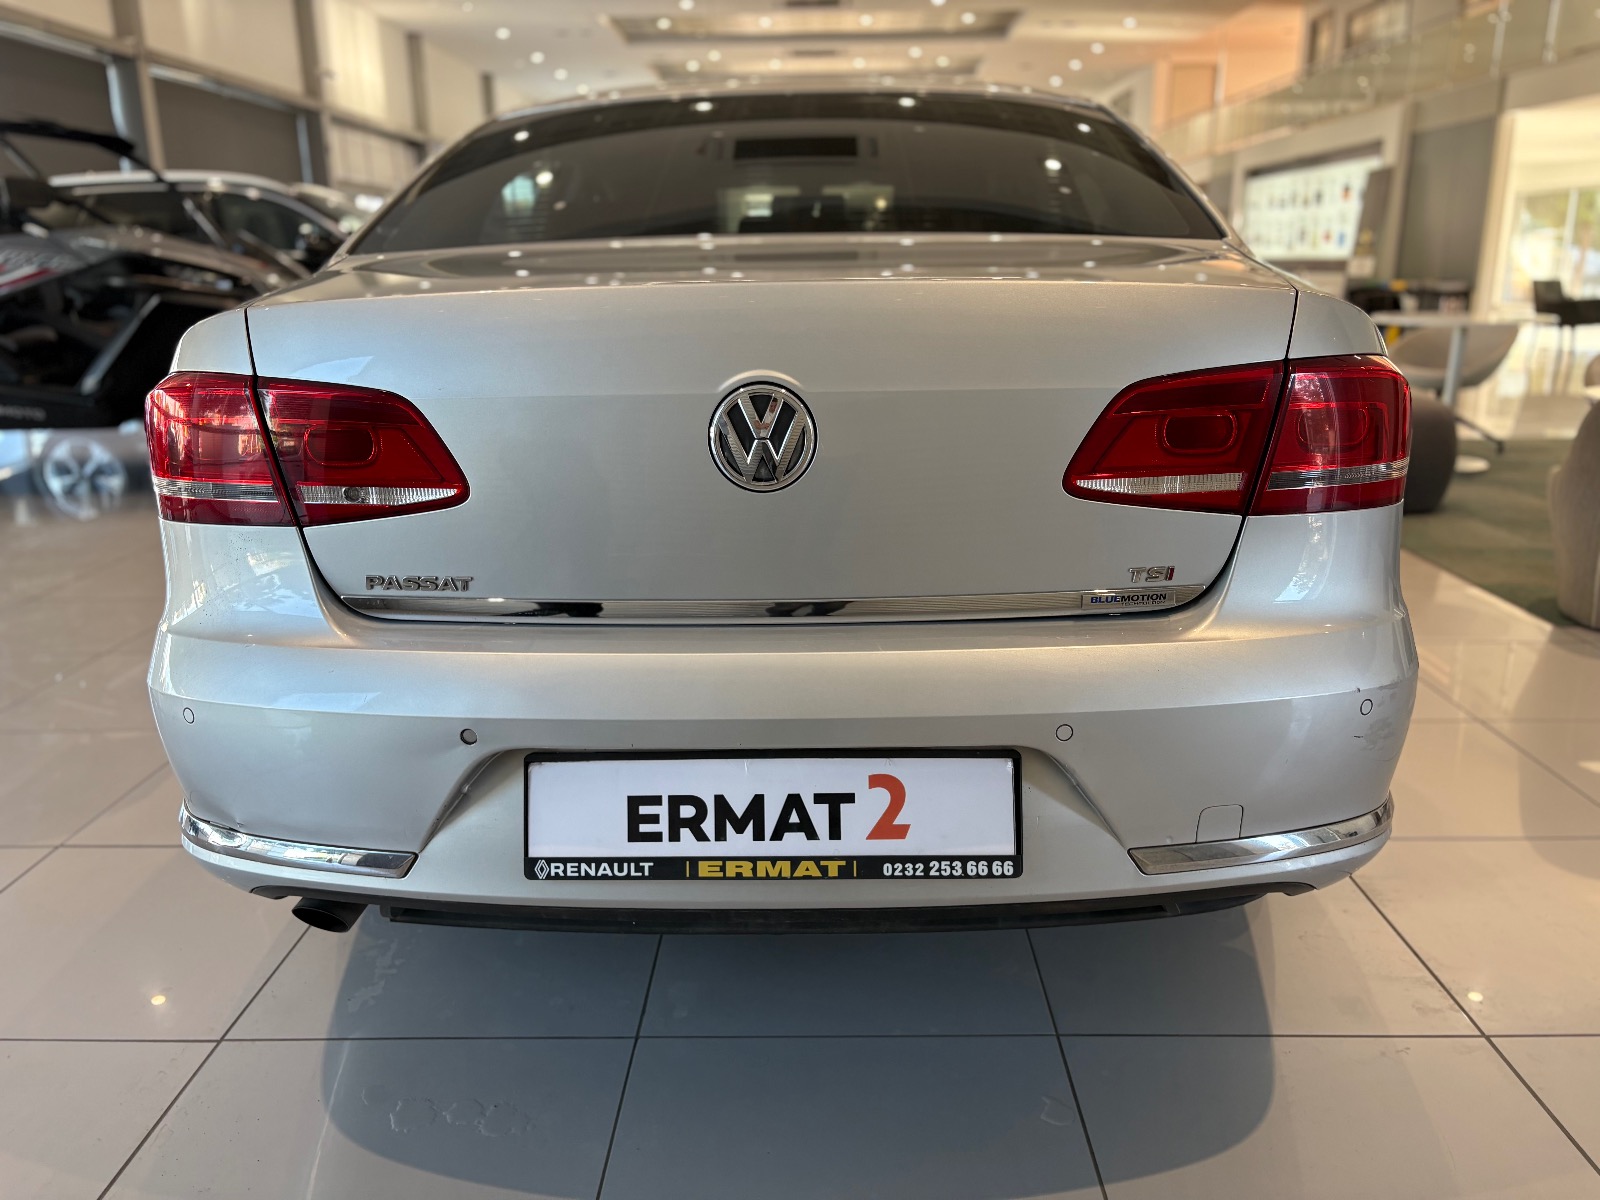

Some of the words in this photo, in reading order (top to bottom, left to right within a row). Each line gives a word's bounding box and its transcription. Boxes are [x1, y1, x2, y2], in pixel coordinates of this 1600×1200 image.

[1128, 565, 1175, 583] TSI
[365, 574, 474, 592] PASSAT
[1090, 593, 1167, 604] BLUEMOTION
[627, 793, 855, 842] ERMAT
[865, 774, 911, 841] 2
[550, 862, 654, 877] RENAULT
[698, 860, 846, 877] ERMAT
[883, 863, 924, 876] 0232
